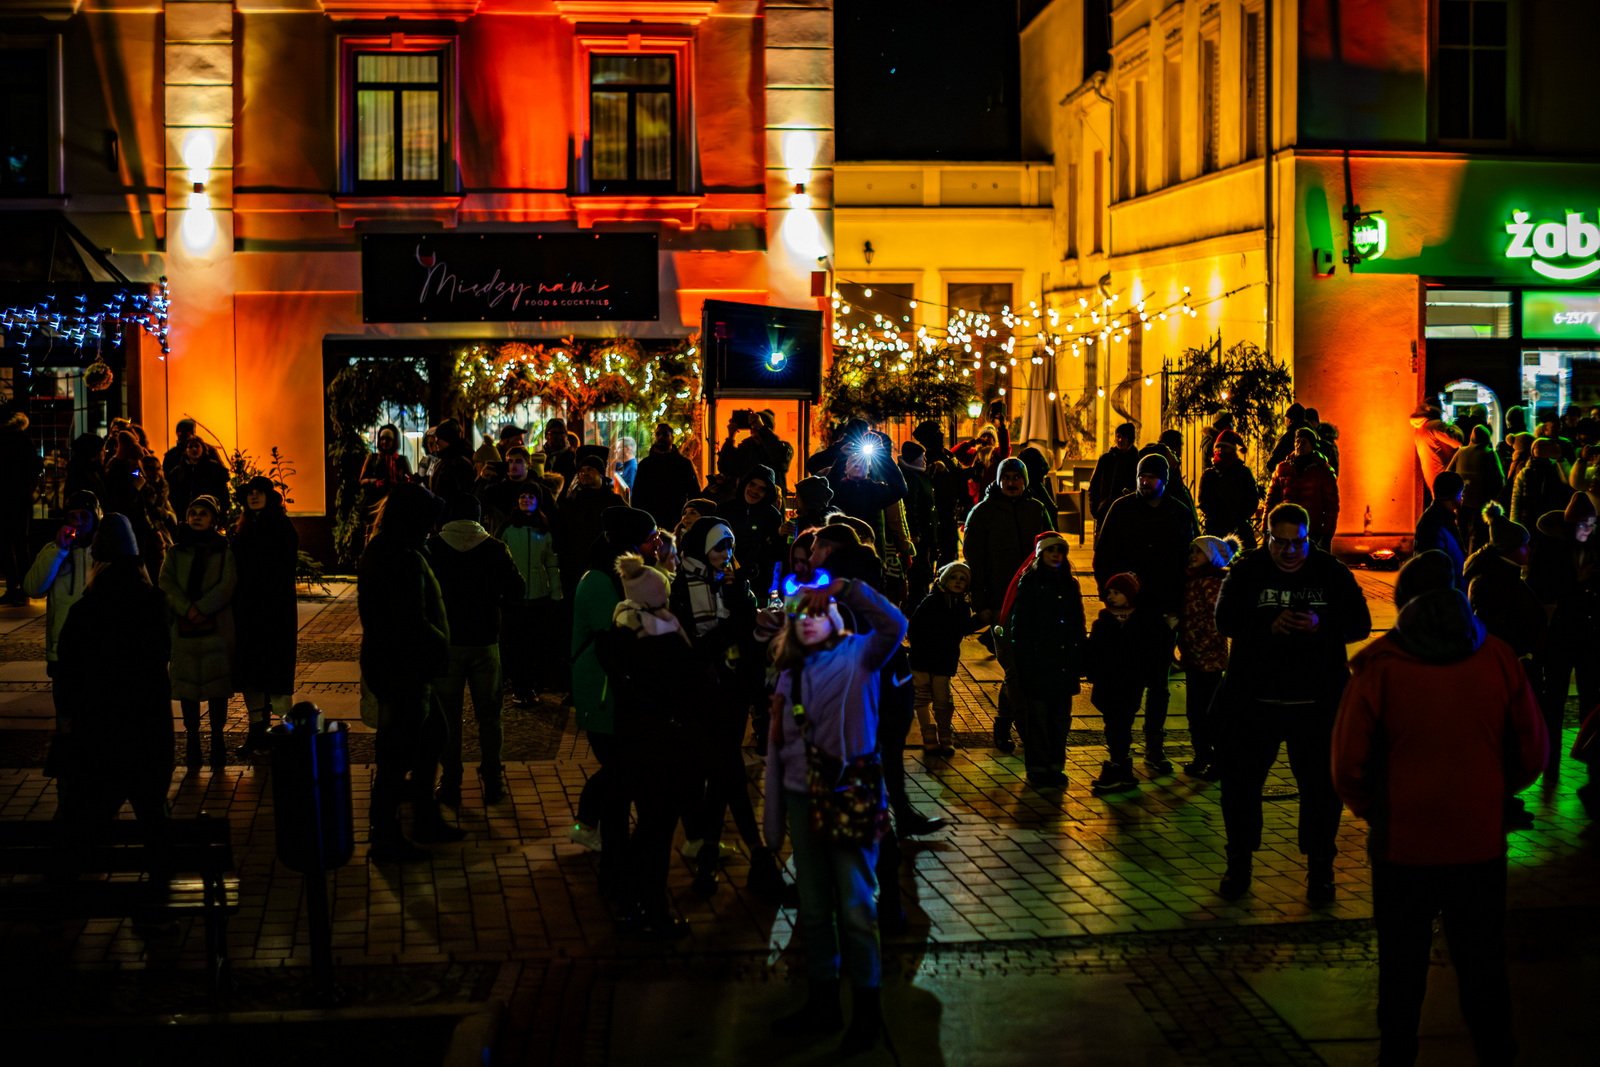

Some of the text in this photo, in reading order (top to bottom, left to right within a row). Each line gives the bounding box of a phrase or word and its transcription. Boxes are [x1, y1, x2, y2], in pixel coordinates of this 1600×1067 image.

[1505, 211, 1600, 258] żab
[538, 277, 610, 293] nami
[525, 299, 609, 307] FOOD & COCKTAILS
